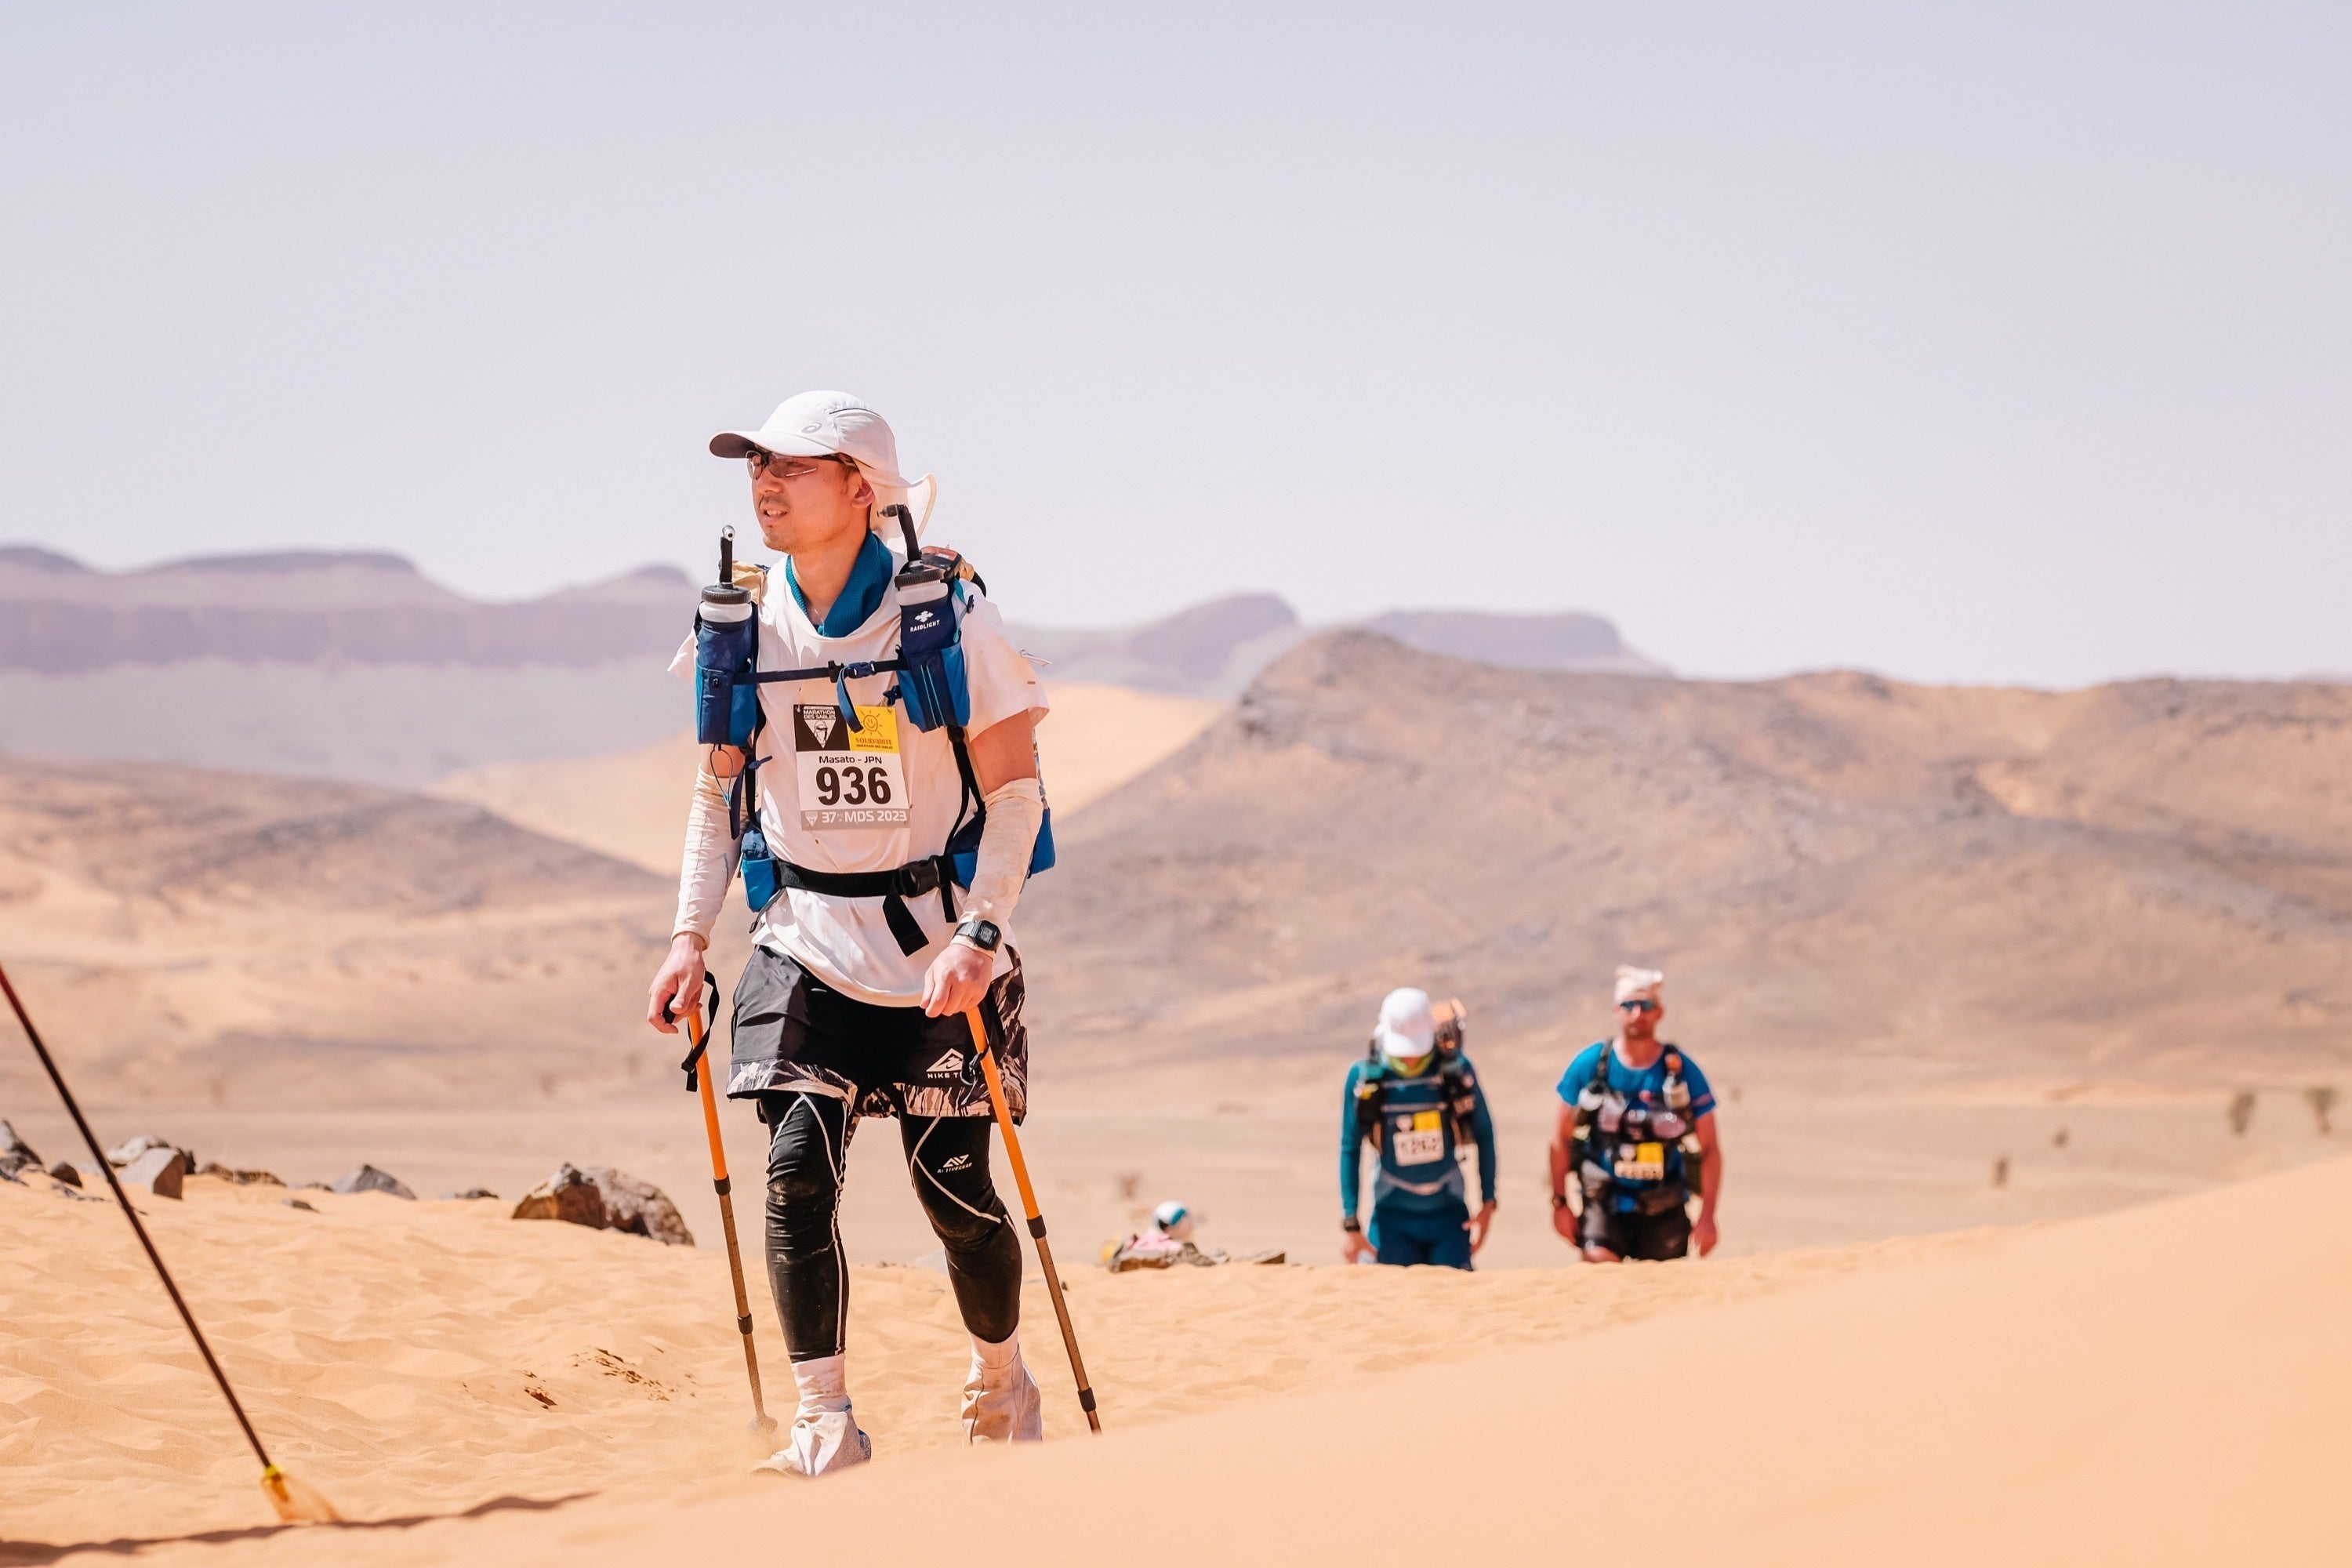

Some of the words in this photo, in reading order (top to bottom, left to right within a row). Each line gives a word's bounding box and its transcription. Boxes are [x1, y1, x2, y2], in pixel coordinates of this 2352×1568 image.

[909, 619, 941, 633] RAIDLIGHT
[815, 766, 891, 806] 936
[822, 811, 837, 823] 37
[844, 811, 875, 822] MDS
[877, 810, 907, 822] 2023
